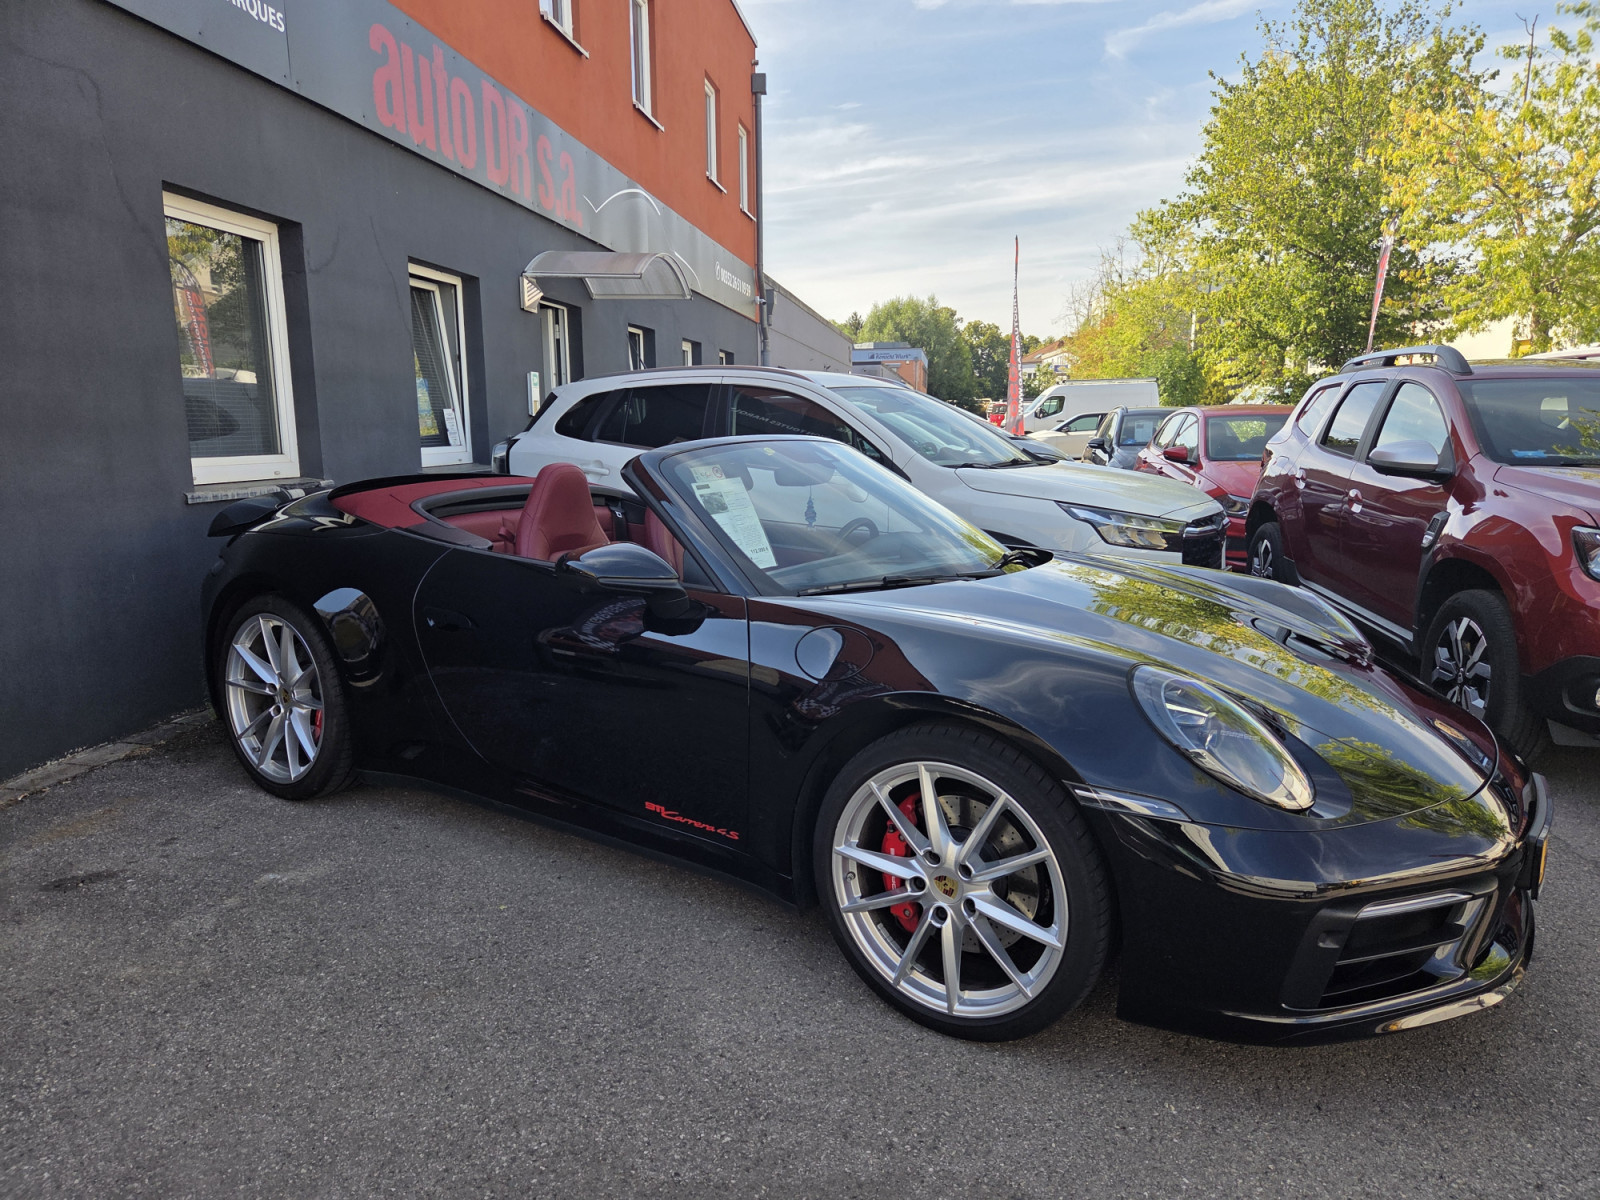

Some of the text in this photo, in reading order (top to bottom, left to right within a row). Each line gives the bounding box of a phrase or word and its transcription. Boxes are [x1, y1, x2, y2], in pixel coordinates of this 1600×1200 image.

[369, 23, 477, 170] auto
[481, 79, 531, 201] DR
[661, 811, 716, 832] Carrera
